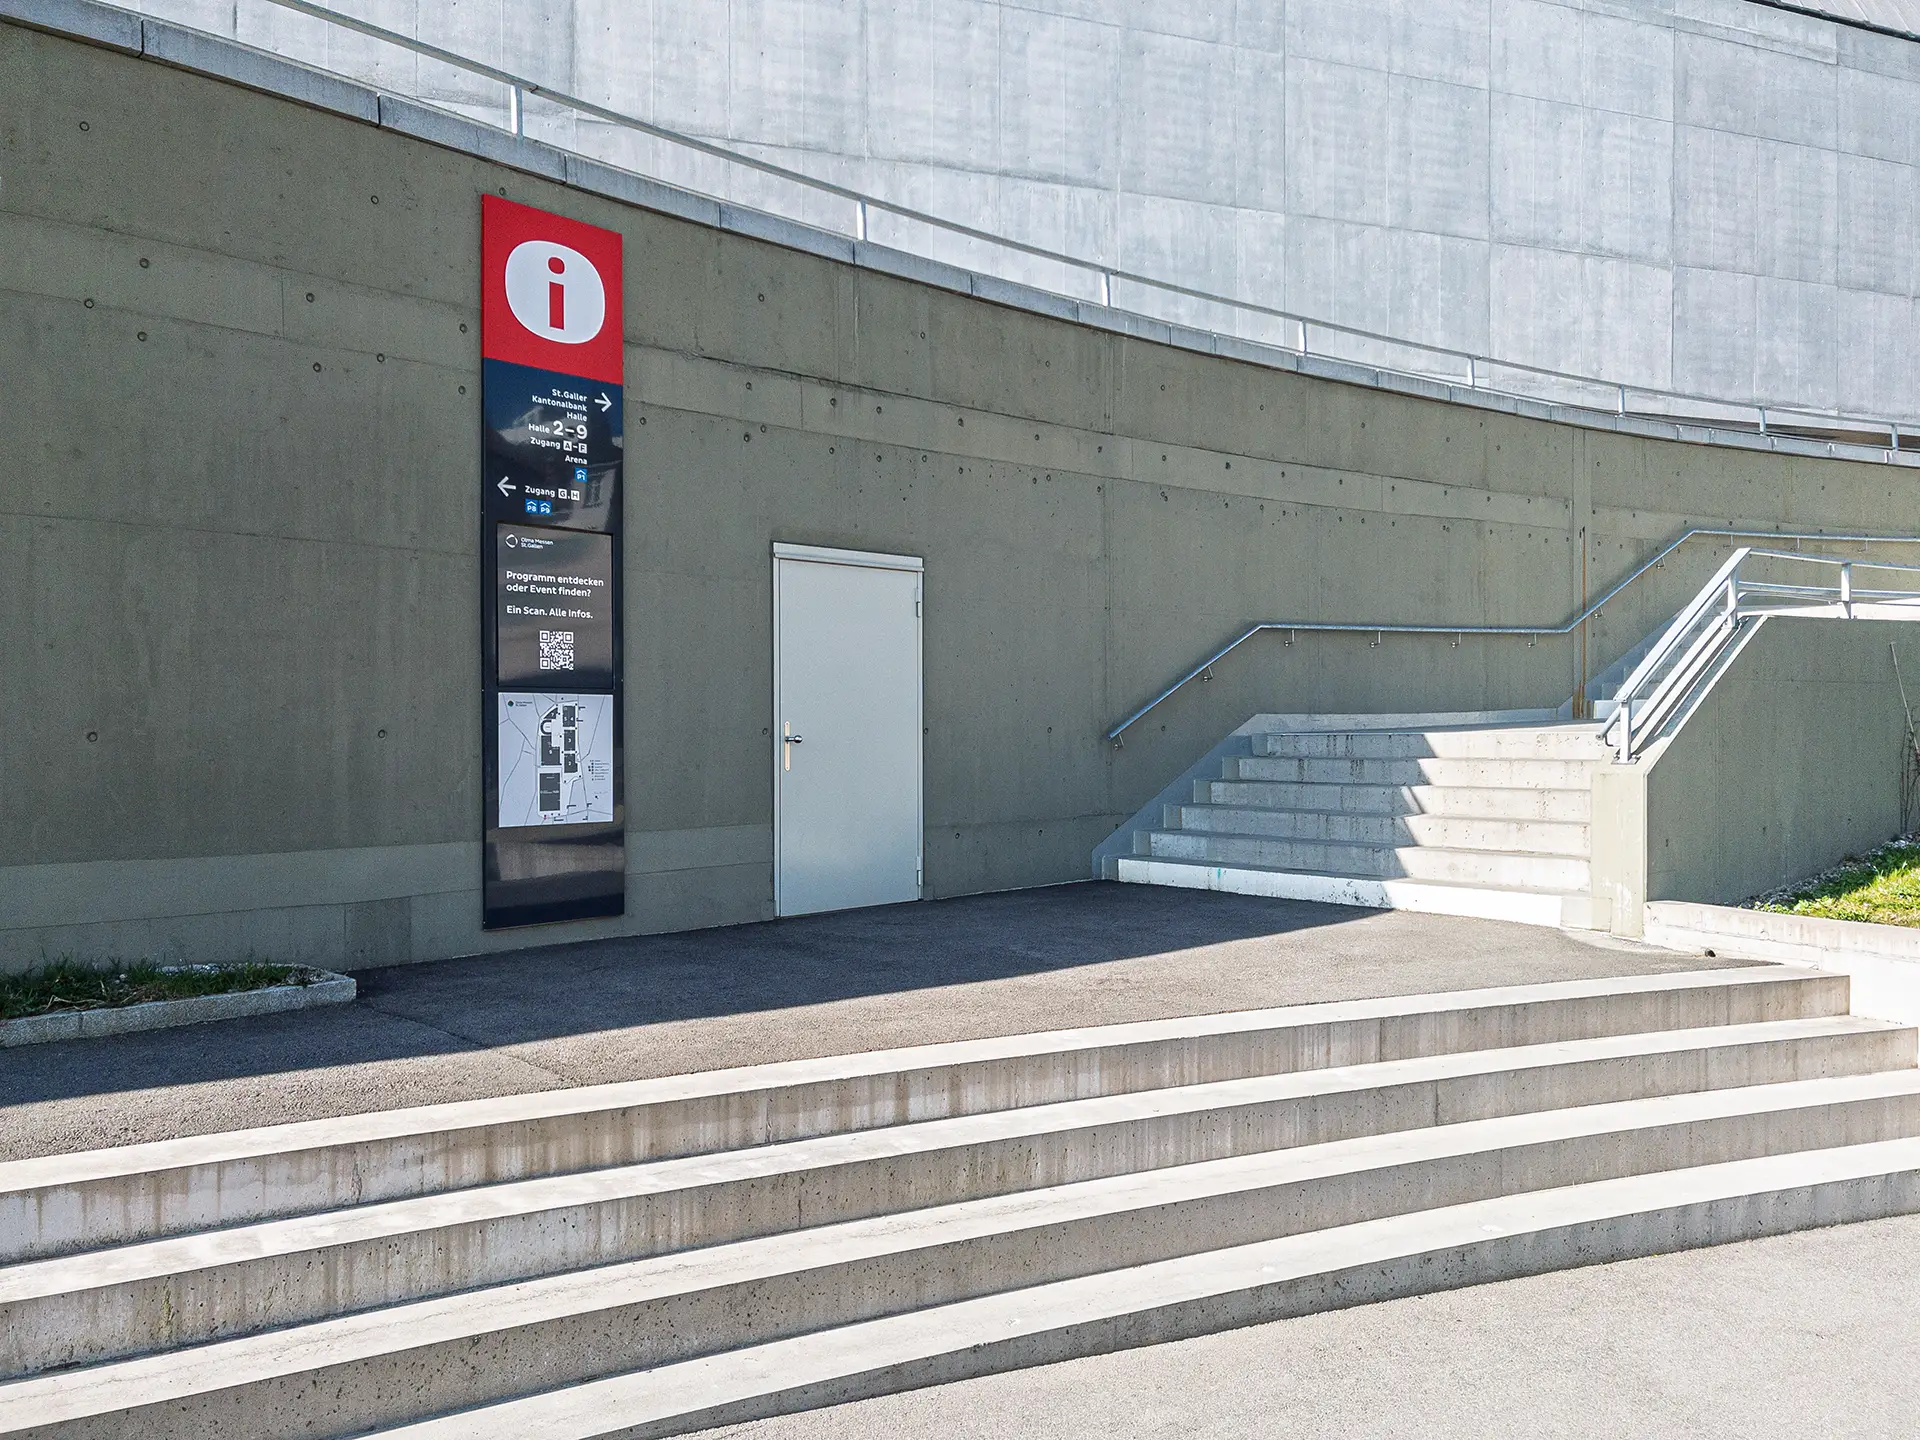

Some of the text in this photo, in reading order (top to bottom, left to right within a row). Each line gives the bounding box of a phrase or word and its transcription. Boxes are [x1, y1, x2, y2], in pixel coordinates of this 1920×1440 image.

[547, 256, 565, 331] i
[532, 395, 587, 412] Kantonalbank
[566, 412, 587, 422] Halle
[528, 423, 550, 434] Halle
[530, 436, 561, 450] Zugang
[565, 455, 588, 465] Arena
[524, 485, 556, 498] Zugang
[506, 570, 604, 587] Programm entdecken
[506, 583, 591, 597] oder Event finden?
[506, 605, 593, 619] Ein Scan. Alle Infos.
